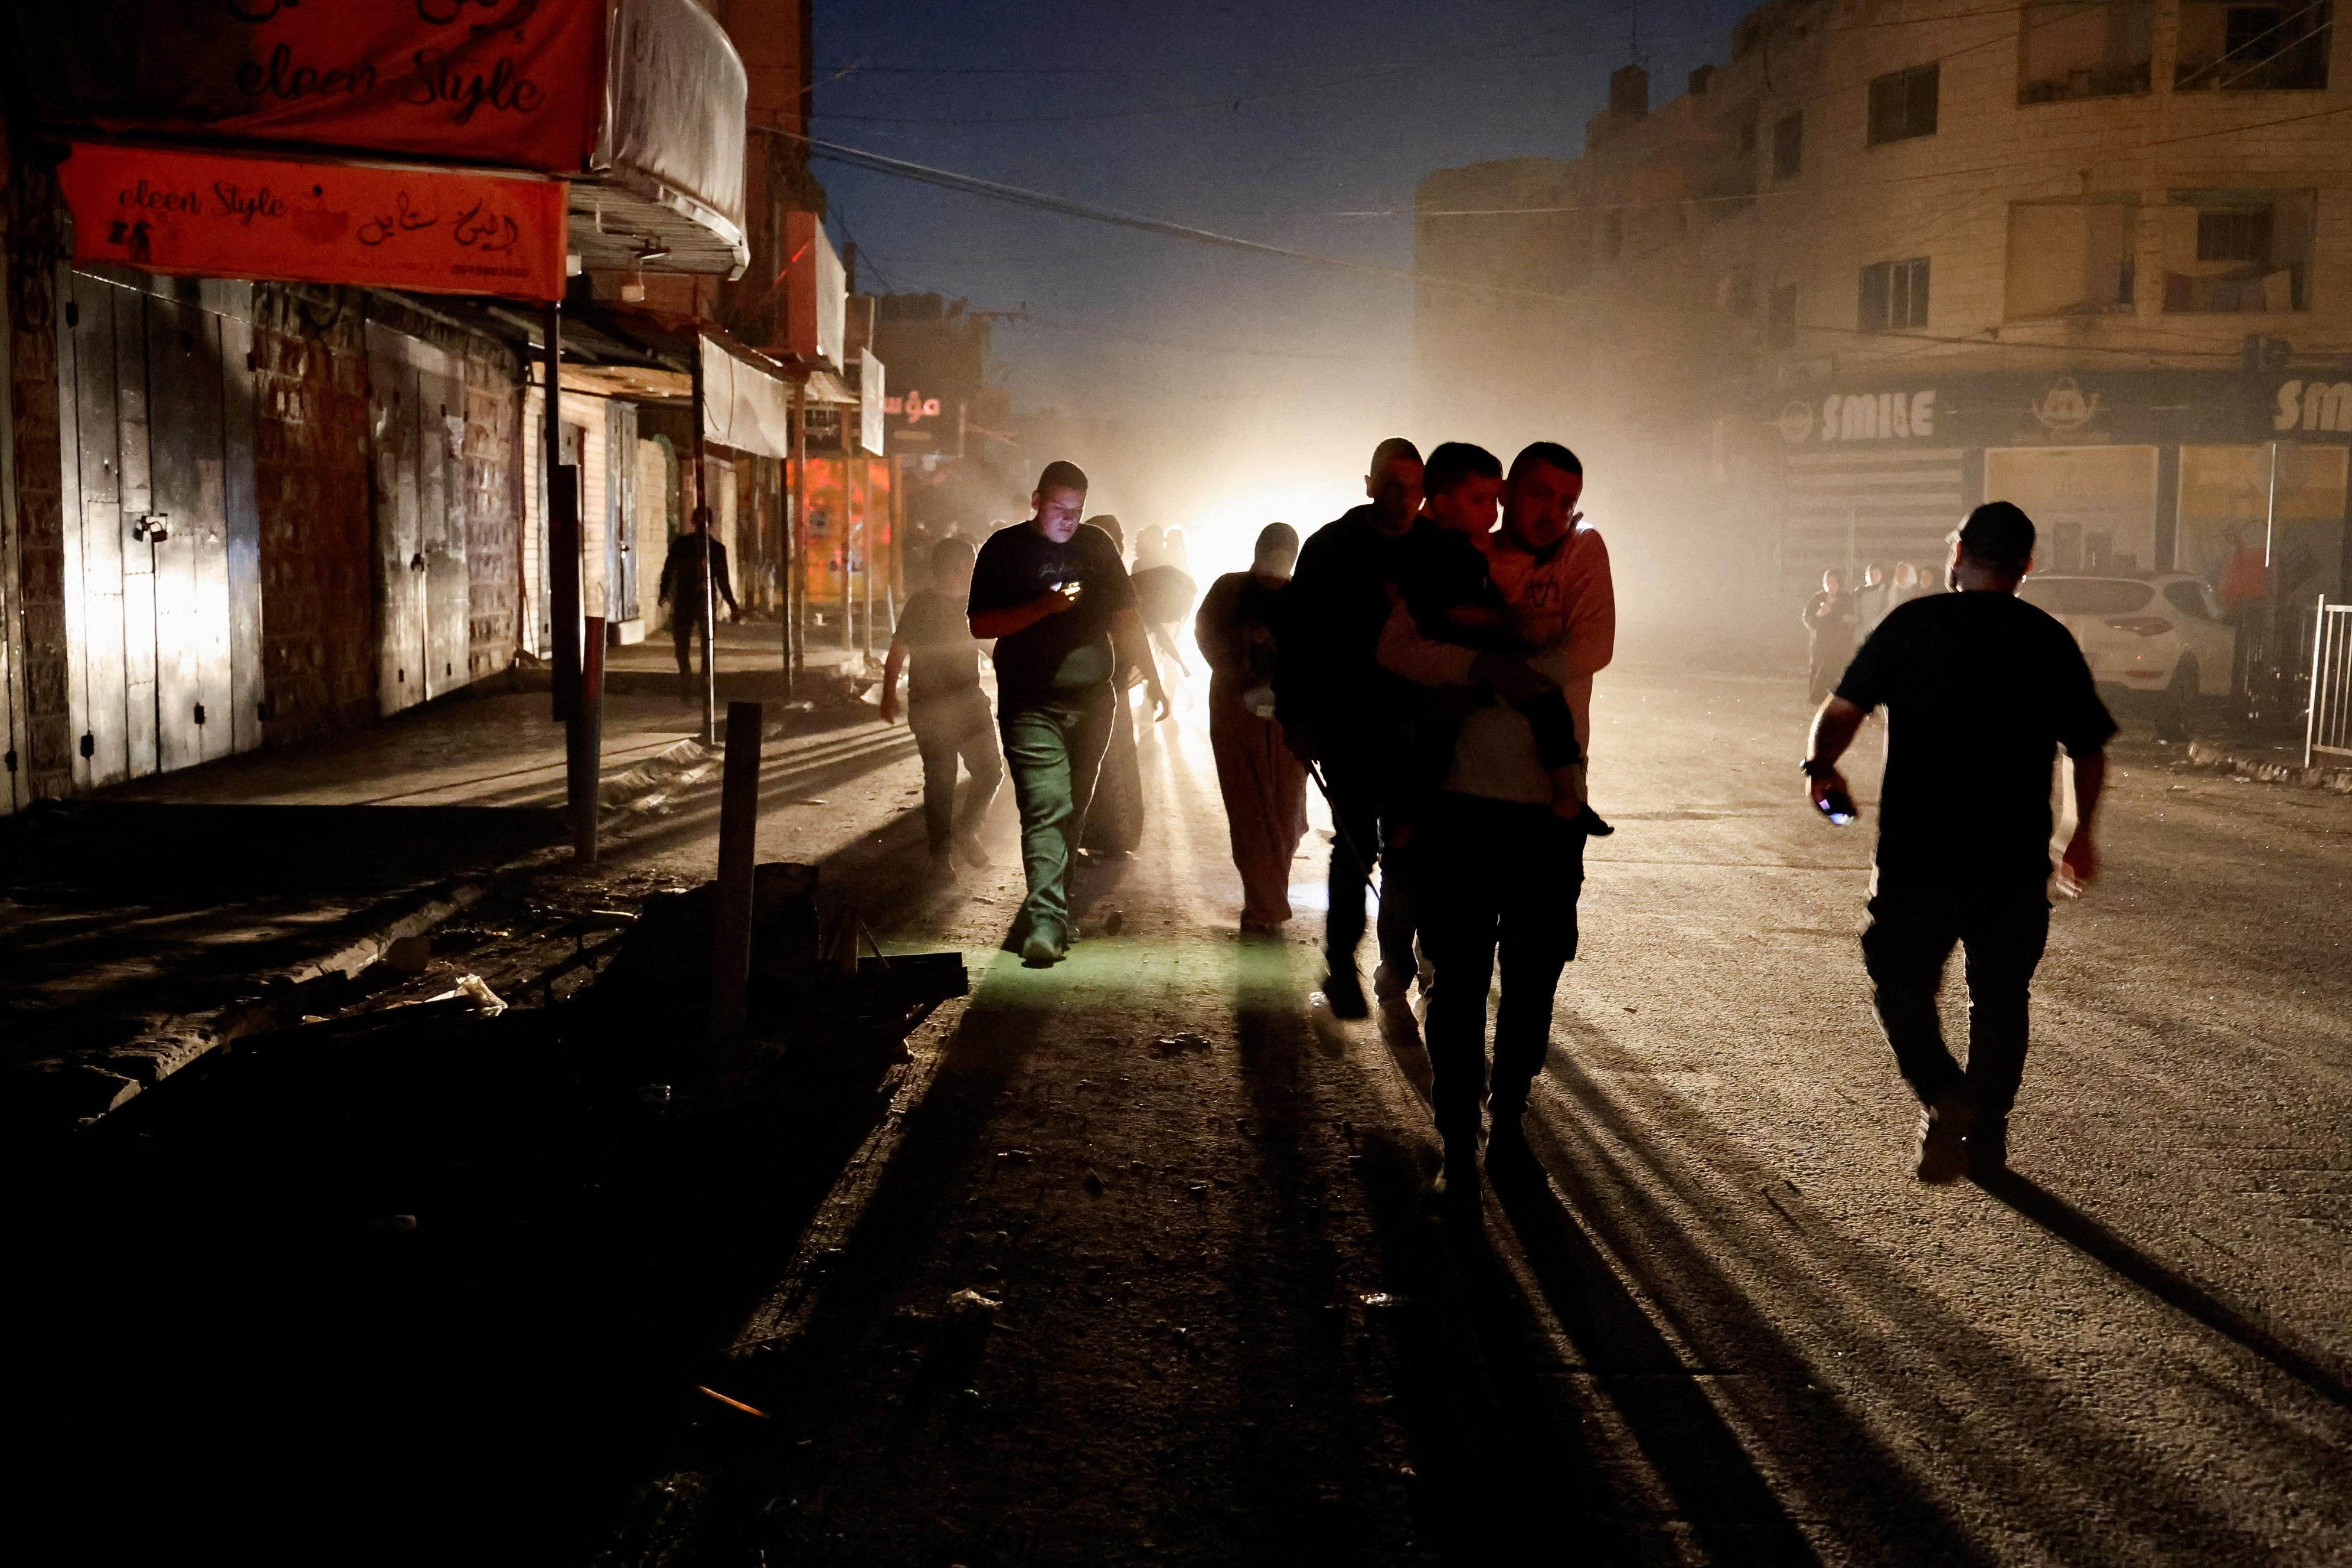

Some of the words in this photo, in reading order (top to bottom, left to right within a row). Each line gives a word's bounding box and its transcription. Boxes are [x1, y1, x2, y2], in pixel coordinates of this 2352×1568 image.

[237, 43, 377, 99] eleen
[401, 47, 546, 126] Style
[119, 179, 203, 215] eleen
[211, 180, 292, 227] Style
[1822, 390, 1936, 441] SMILE
